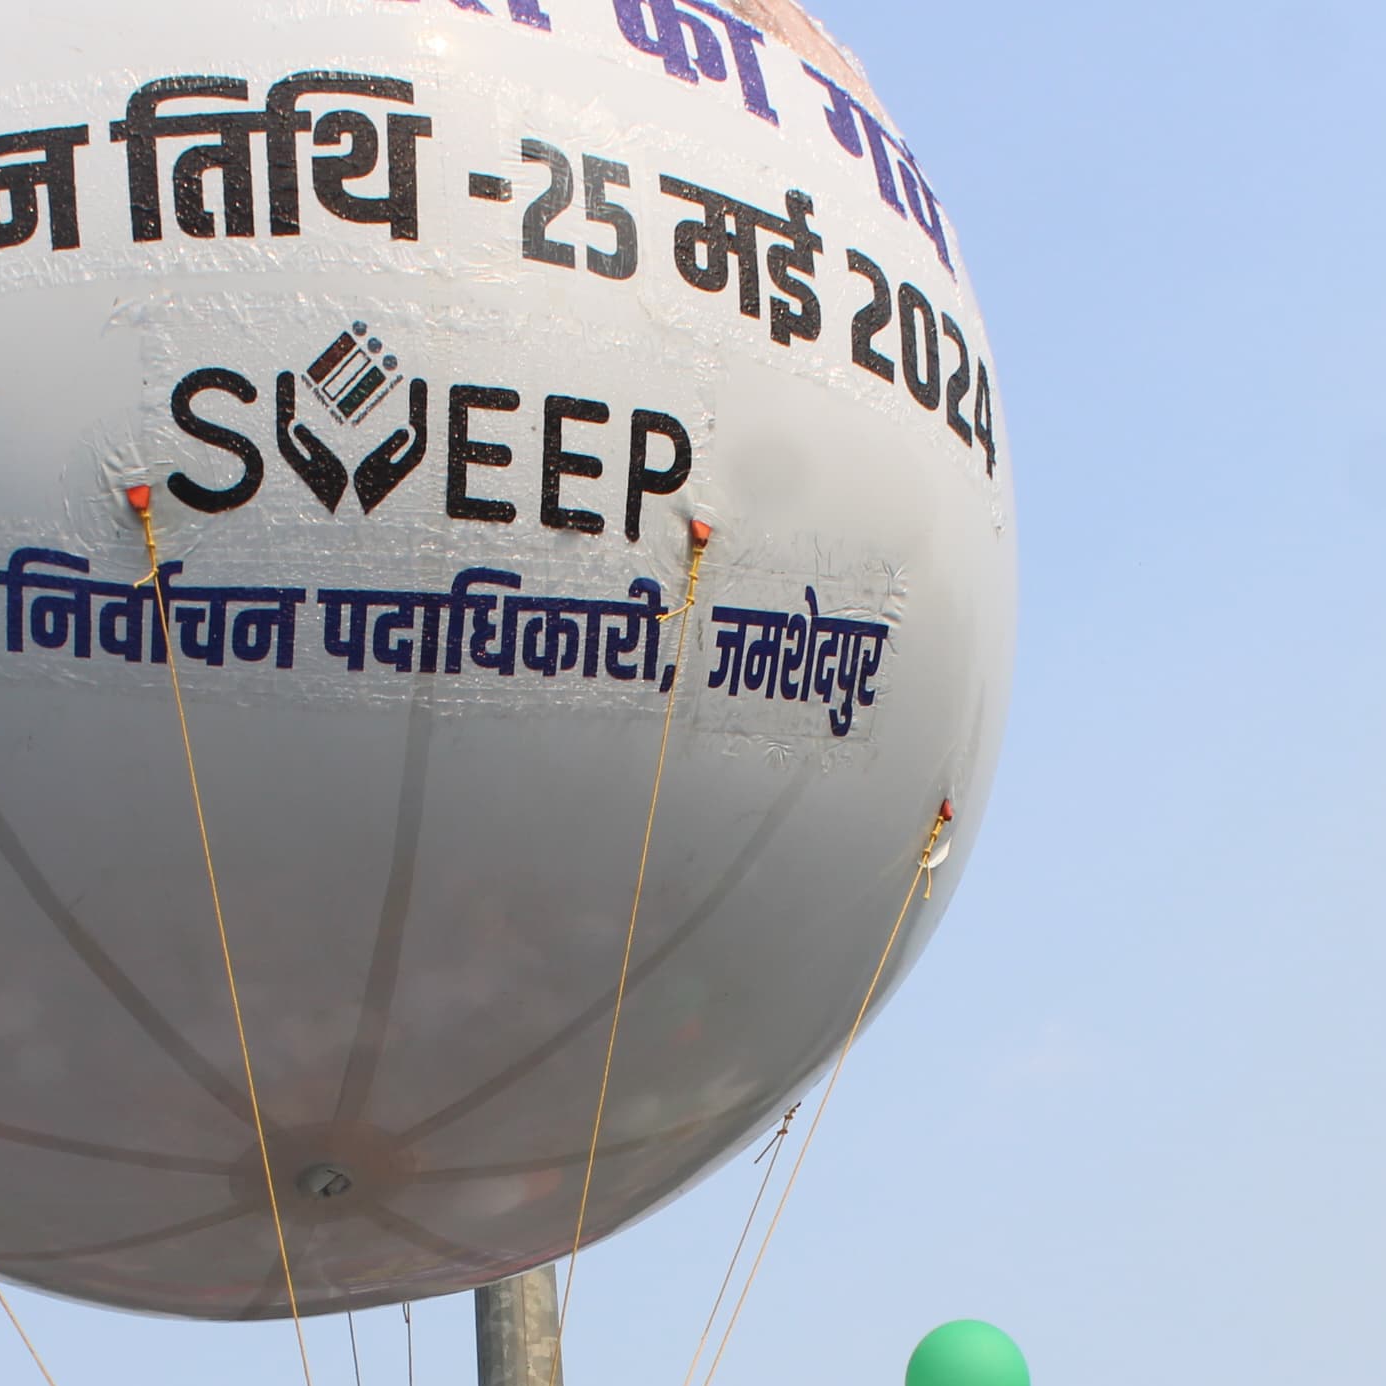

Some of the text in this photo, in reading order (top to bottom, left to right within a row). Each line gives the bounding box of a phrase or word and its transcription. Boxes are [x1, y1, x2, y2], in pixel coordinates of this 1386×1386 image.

[110, 71, 432, 241] तिथि
[659, 189, 823, 347] मई
[845, 248, 1000, 481] 2024
[0, 547, 306, 670] निर्वाचन
[317, 567, 677, 693] पदाधिकारी,
[708, 586, 889, 737] जमशेदपुर
